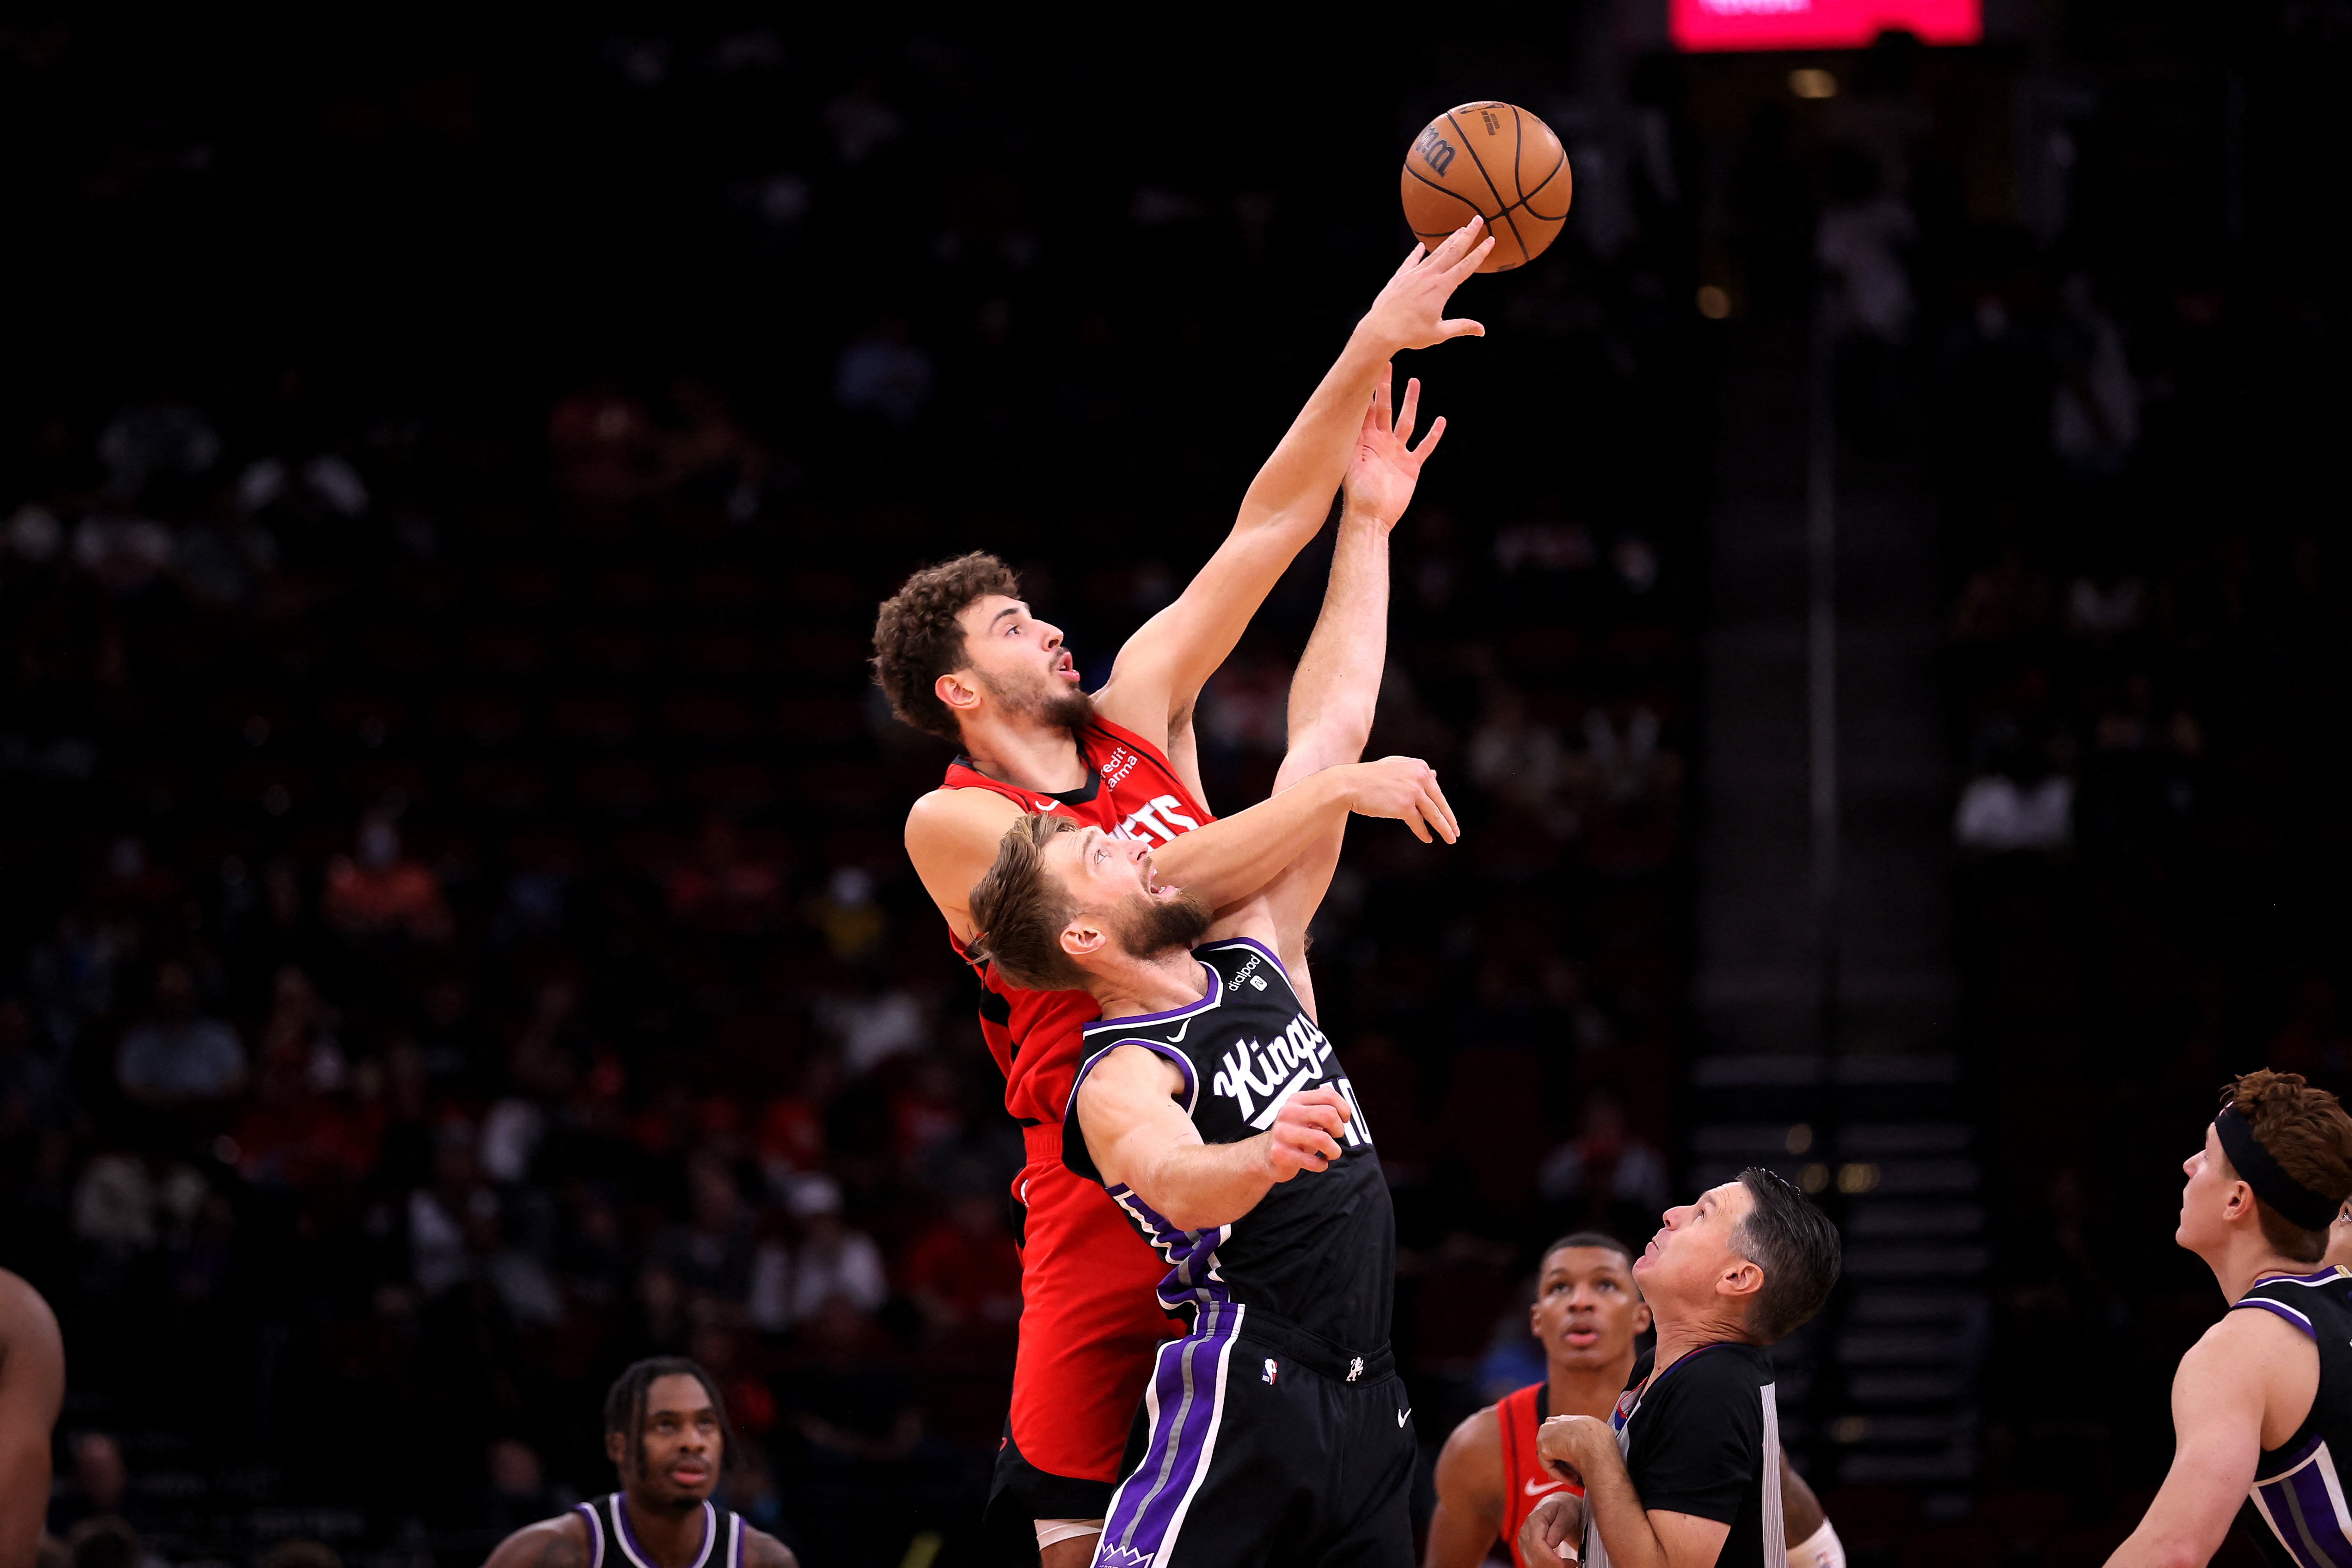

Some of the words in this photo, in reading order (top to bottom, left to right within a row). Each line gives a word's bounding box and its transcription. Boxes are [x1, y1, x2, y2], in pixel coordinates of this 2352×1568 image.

[1100, 747, 1127, 781] redit
[1107, 755, 1138, 791] arma
[1228, 954, 1261, 991] dialpad
[1212, 1011, 1329, 1124] Kings
